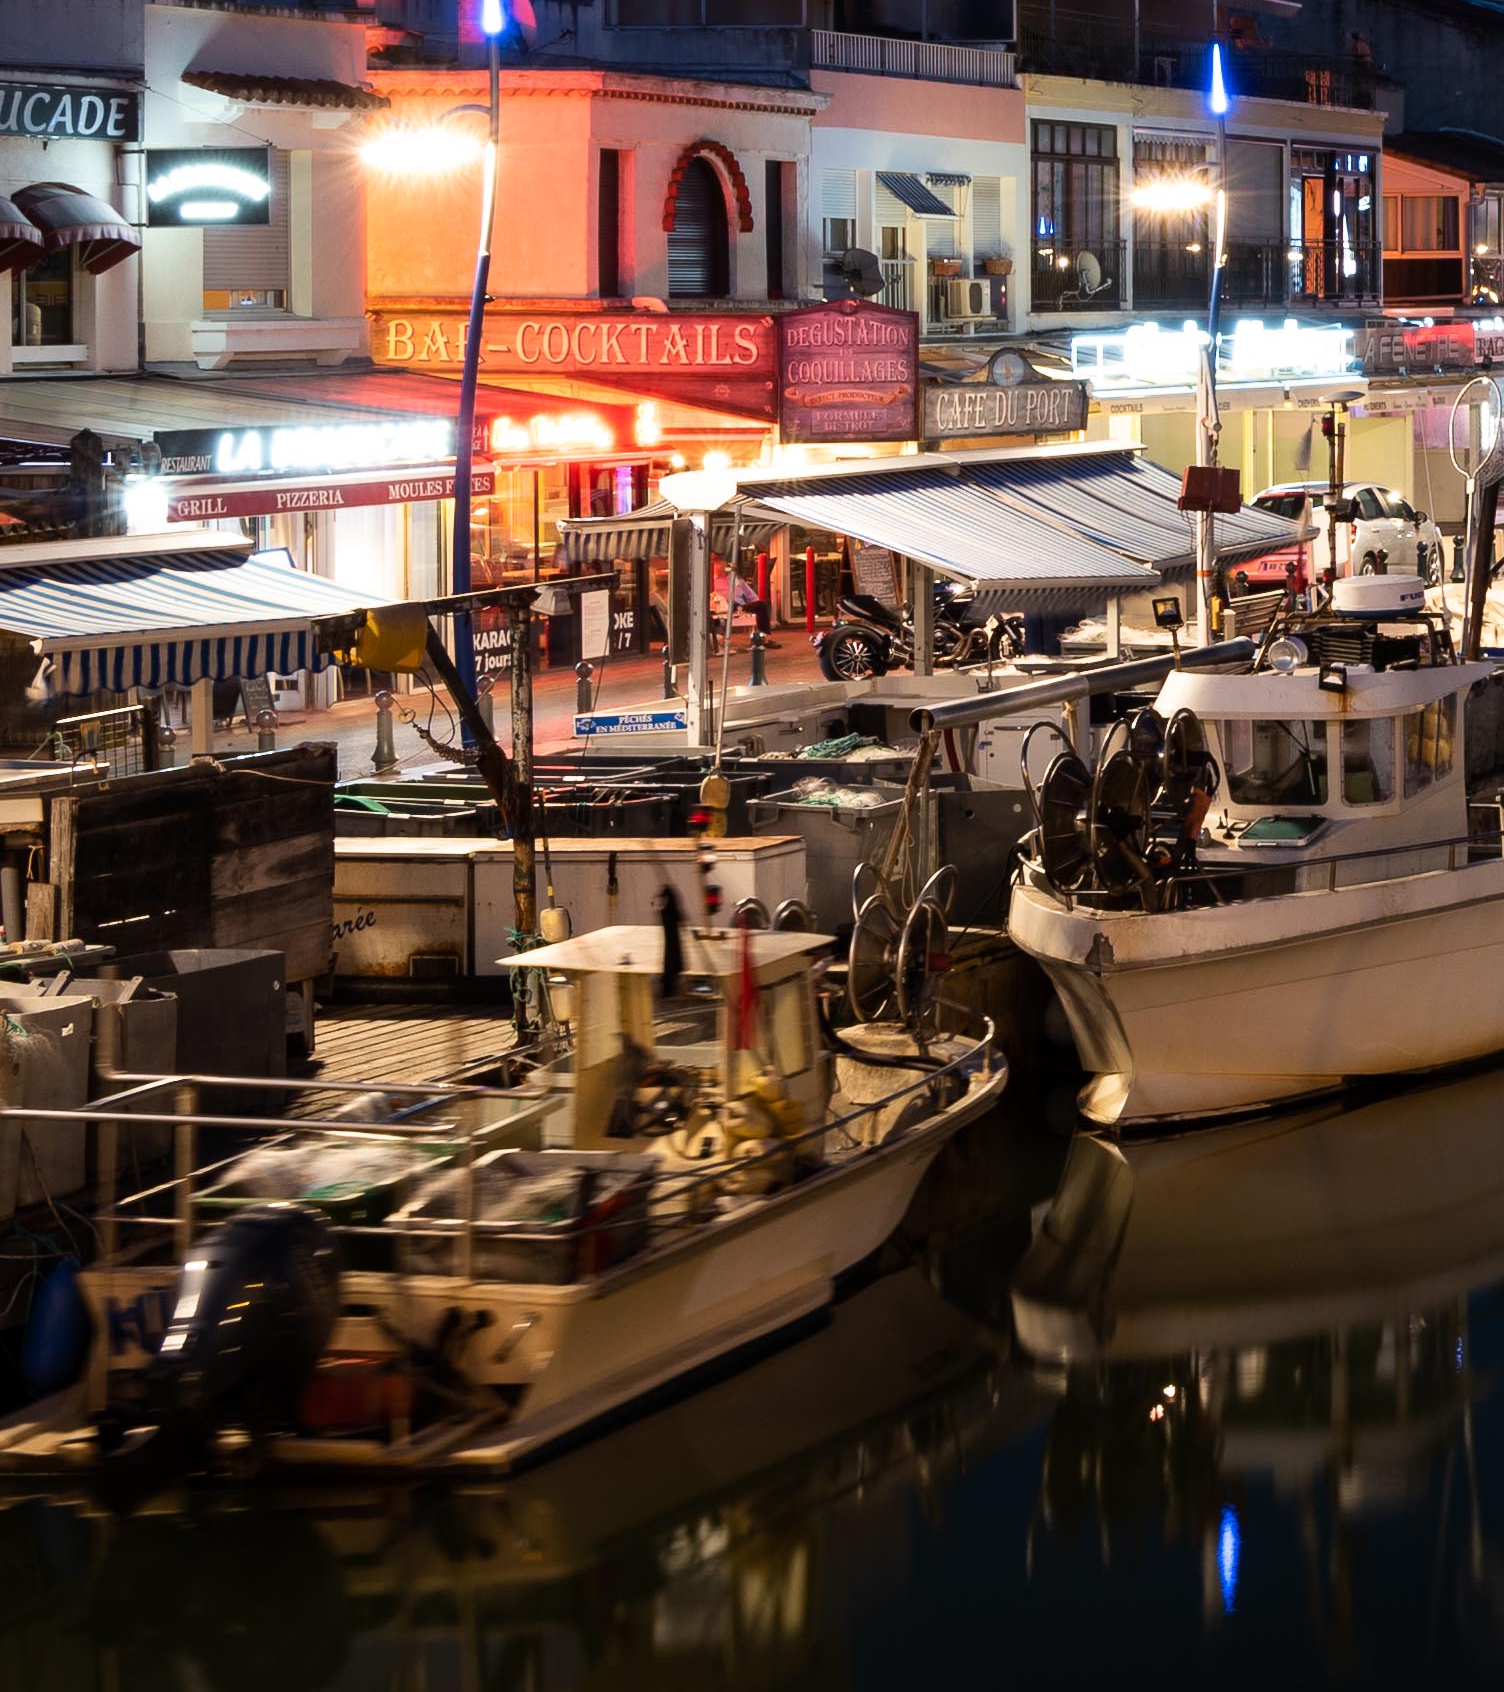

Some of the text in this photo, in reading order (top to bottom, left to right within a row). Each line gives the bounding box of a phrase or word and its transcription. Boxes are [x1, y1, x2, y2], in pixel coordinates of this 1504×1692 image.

[786, 316, 910, 348] DEGUSTATION
[787, 360, 909, 385] COQUILLAGES
[936, 388, 1074, 431] CAFE DU PORT
[1110, 402, 1144, 414] COCKTAILS
[160, 455, 213, 474] RESTAURANT
[177, 475, 491, 517] GRILL PIZZERIA MOULES FTES
[473, 629, 511, 652] KARA
[475, 656, 482, 672] 7
[596, 726, 608, 734] EN
[330, 906, 377, 942] arée
